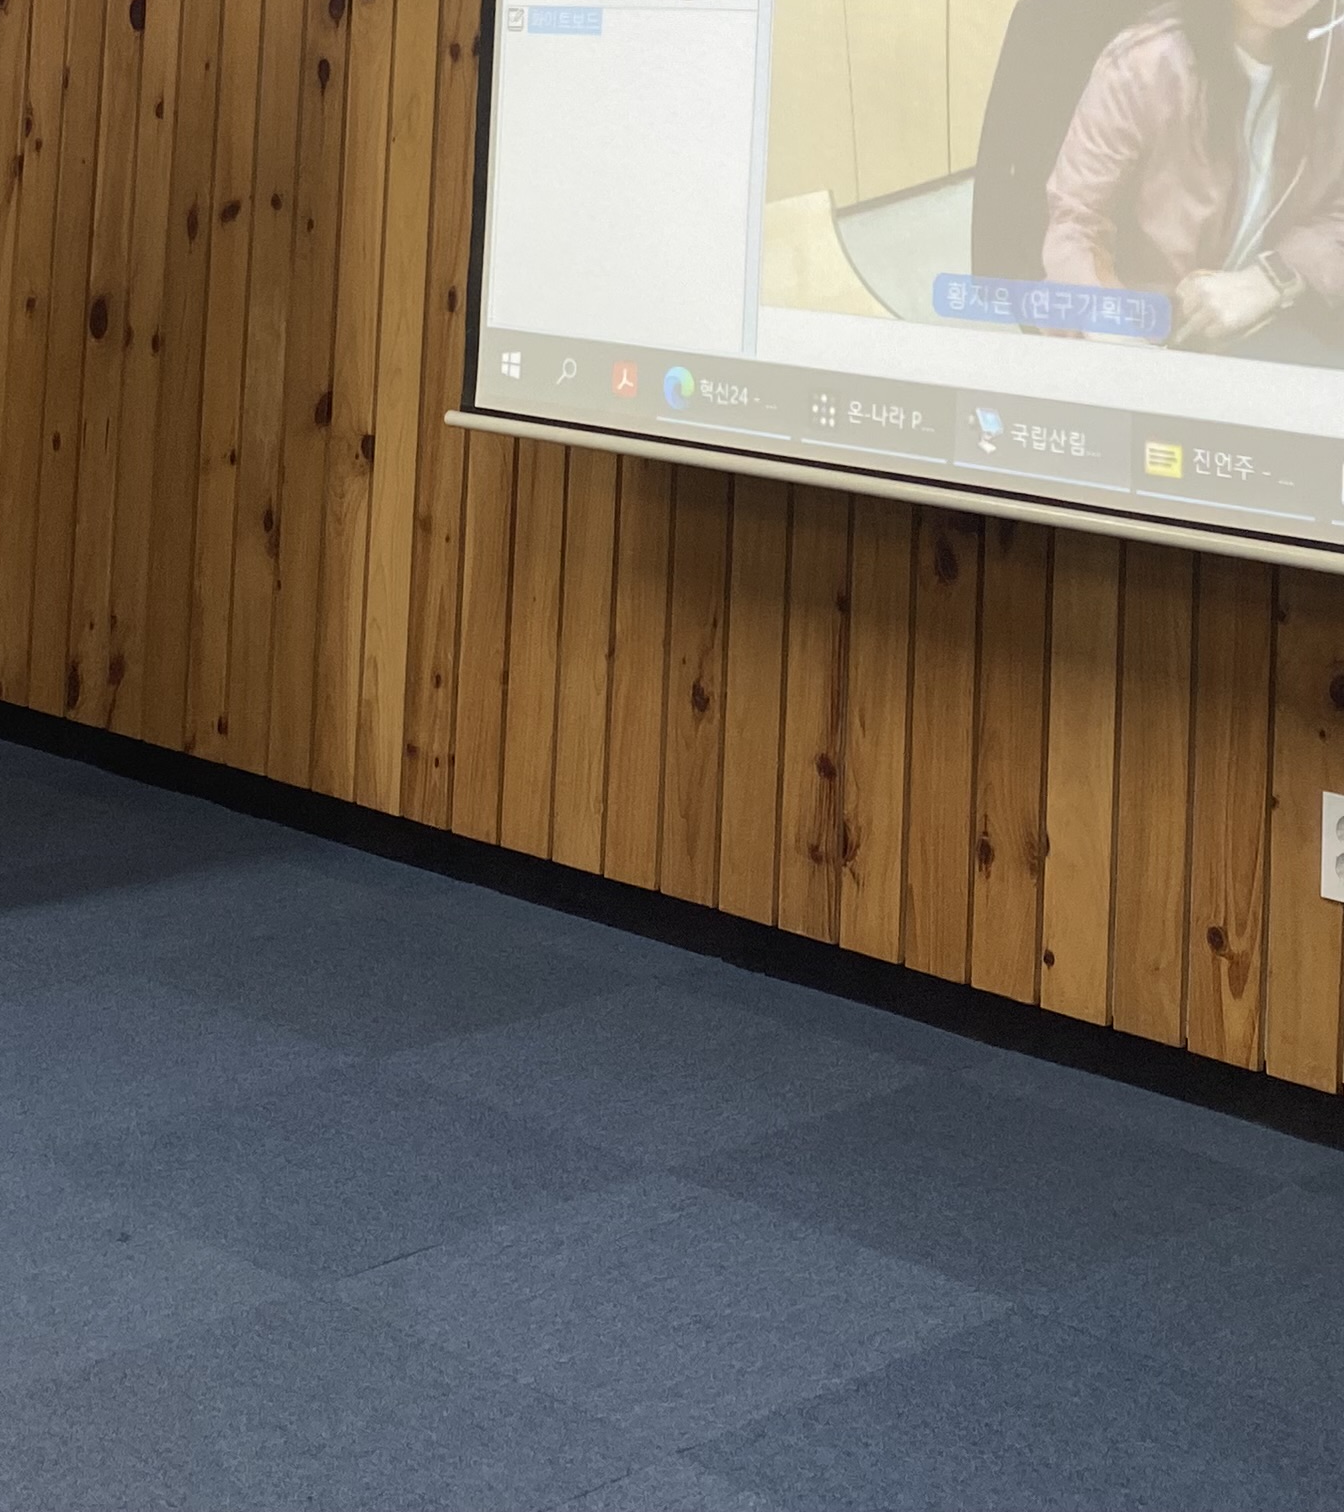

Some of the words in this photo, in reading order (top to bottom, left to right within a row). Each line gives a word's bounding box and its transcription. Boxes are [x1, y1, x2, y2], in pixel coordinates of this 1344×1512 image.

[700, 379, 748, 407] 혁신24
[847, 400, 905, 428] 온-나라
[1193, 449, 1255, 478] 진언주
